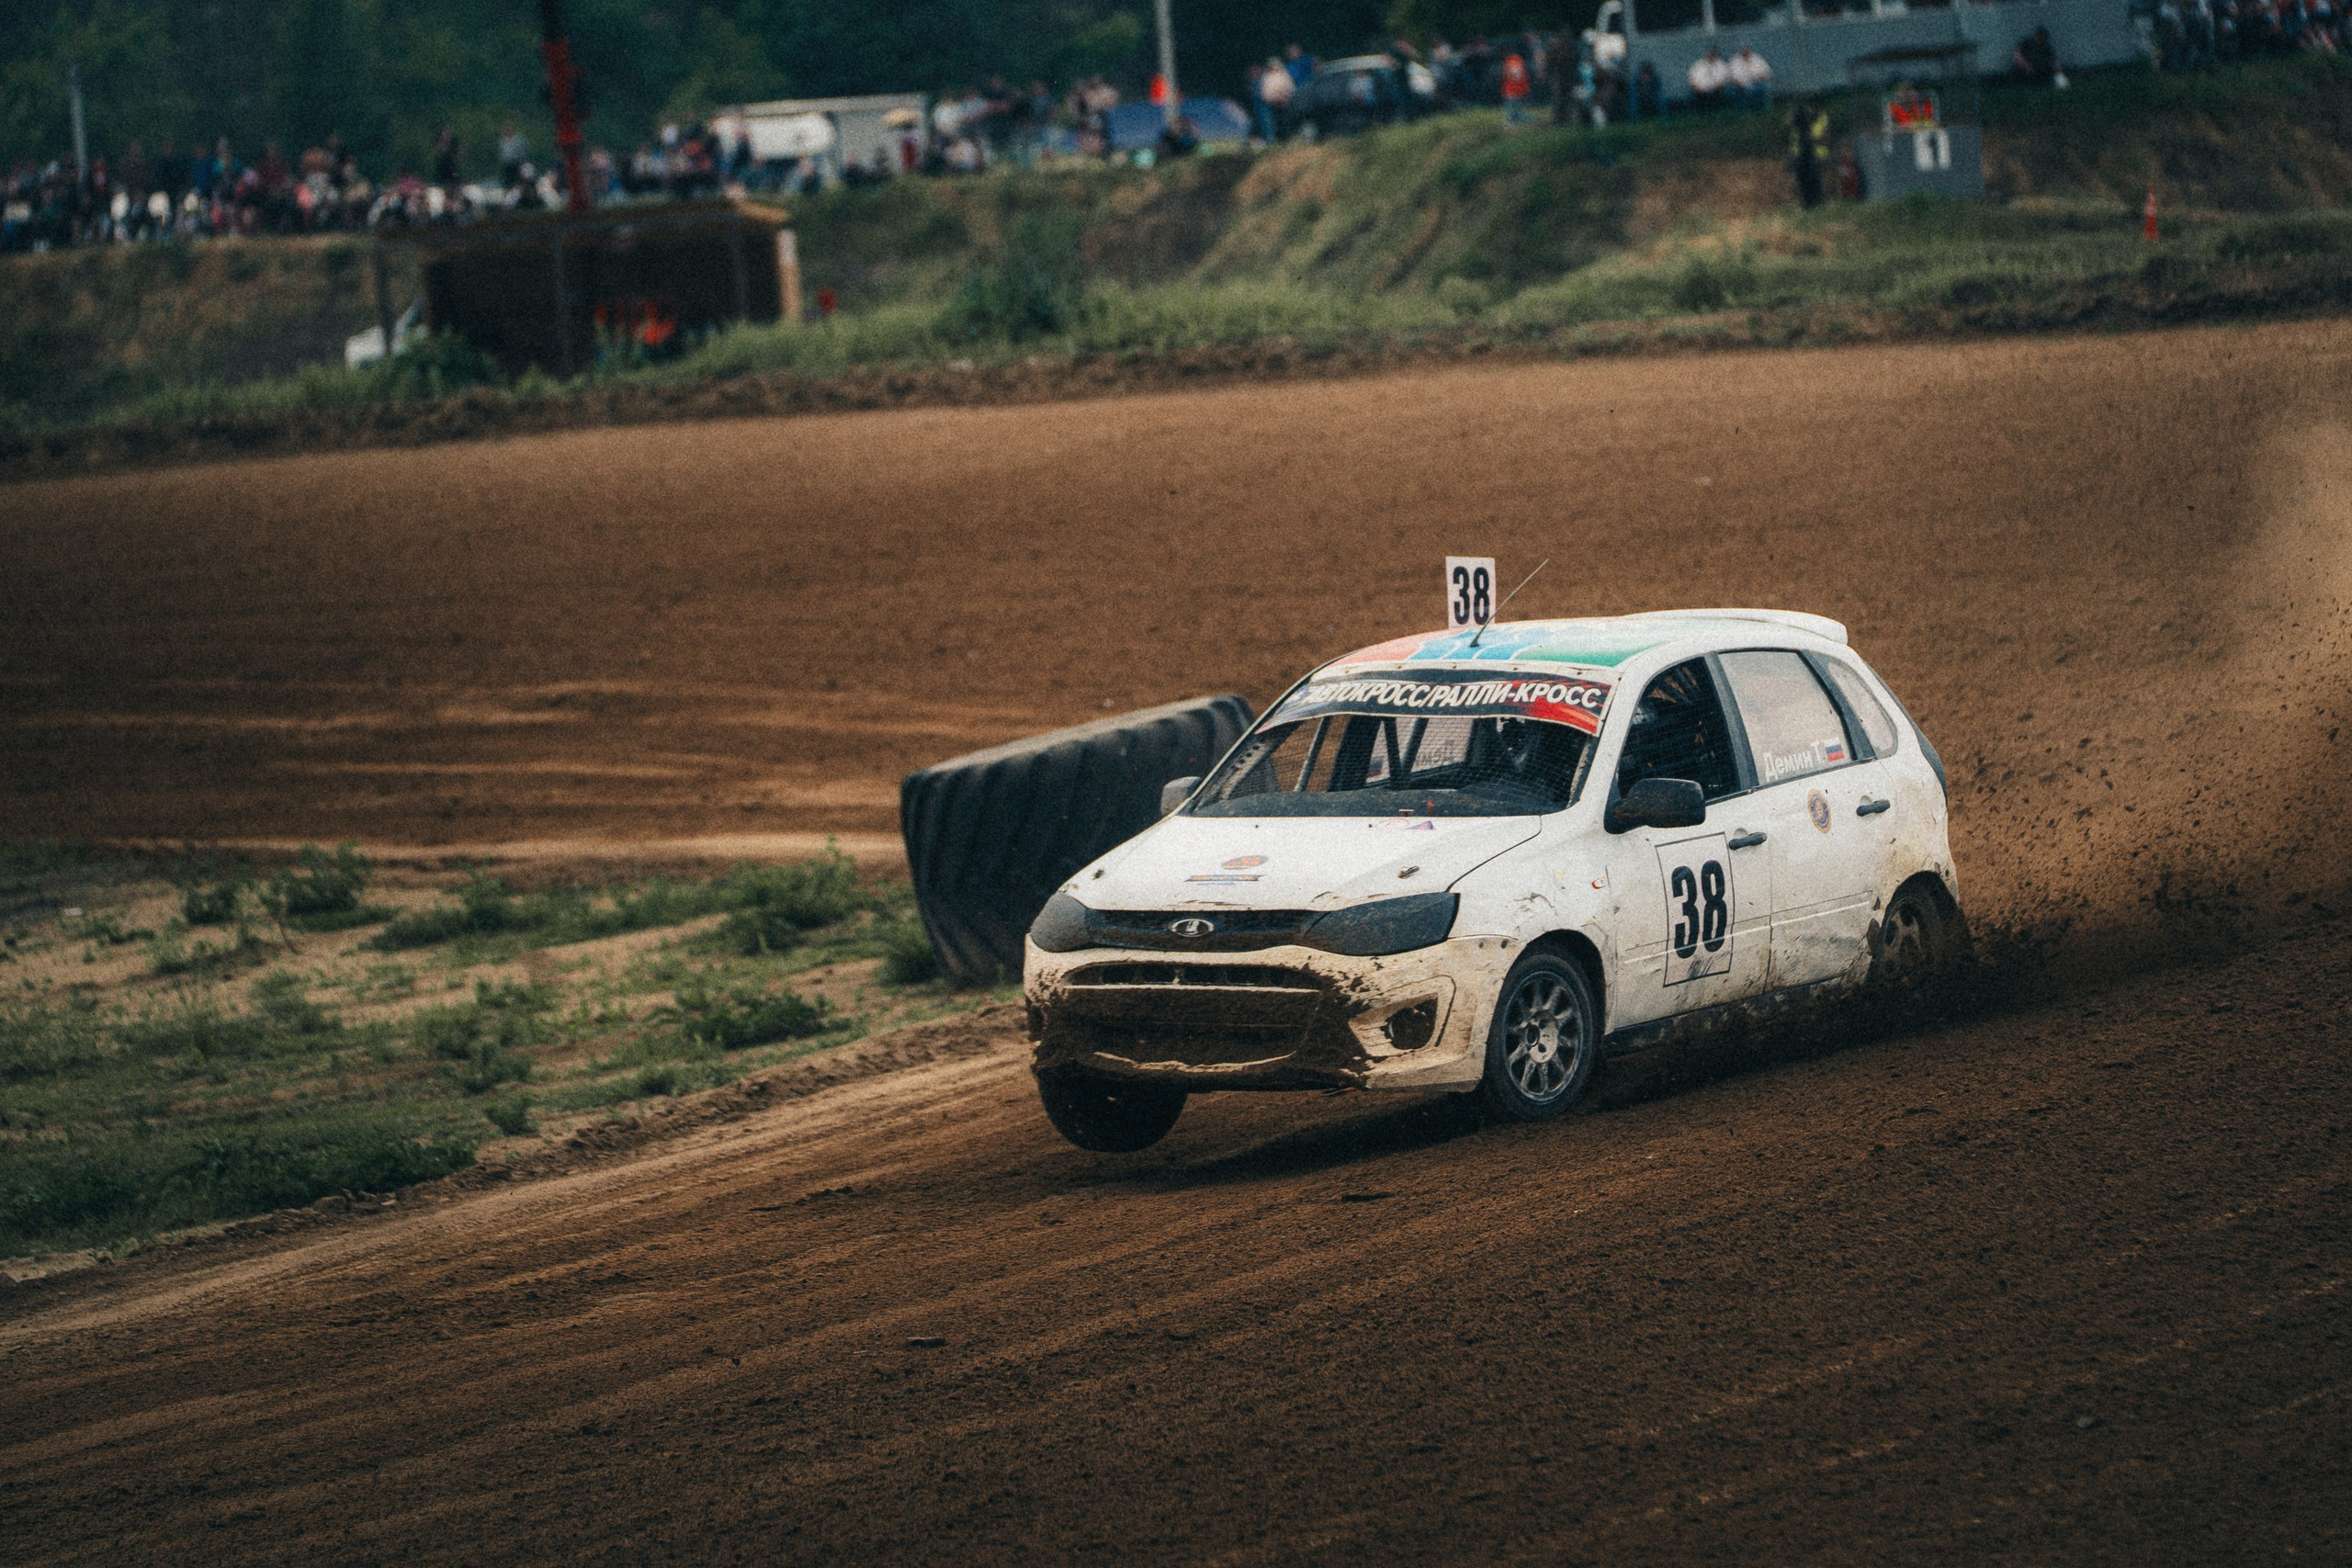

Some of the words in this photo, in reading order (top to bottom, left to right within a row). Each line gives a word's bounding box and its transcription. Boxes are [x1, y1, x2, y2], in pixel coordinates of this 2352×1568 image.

[1453, 566, 1490, 626] 38
[1763, 750, 1814, 782] Демин
[1671, 860, 1727, 959] 38
